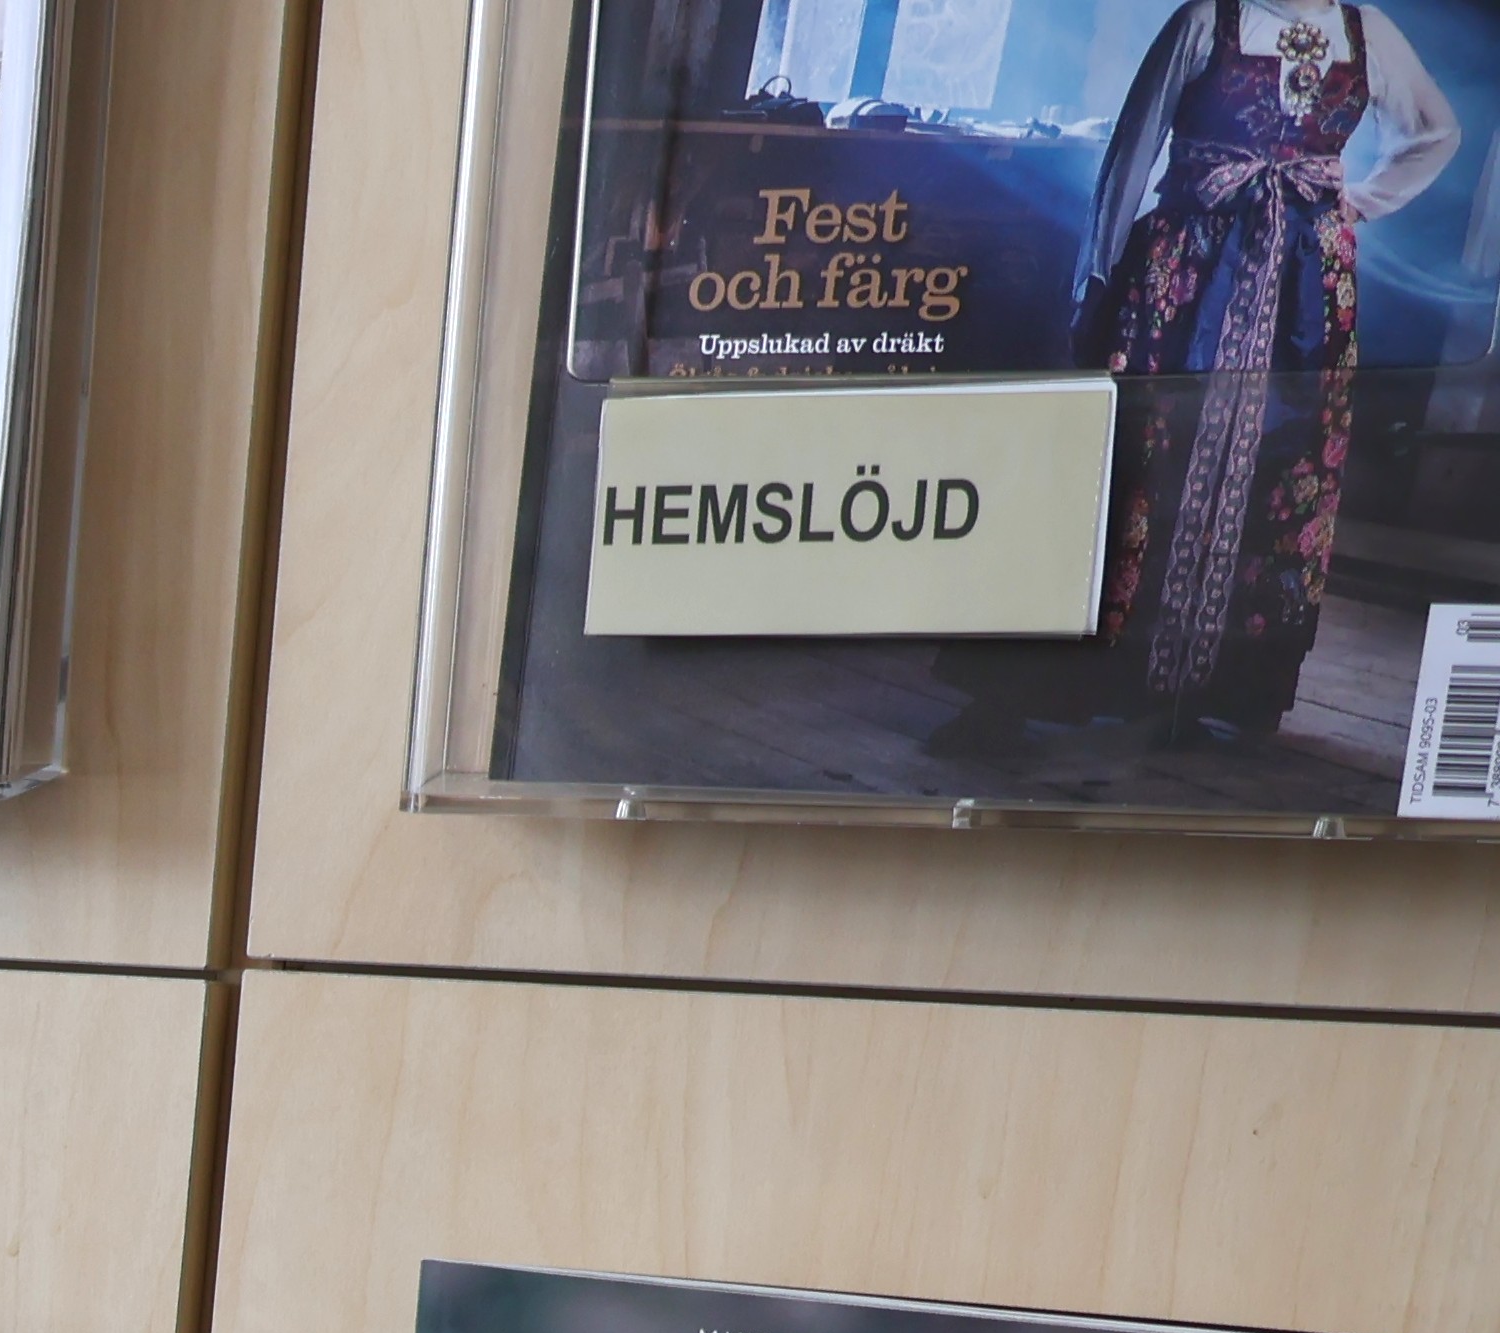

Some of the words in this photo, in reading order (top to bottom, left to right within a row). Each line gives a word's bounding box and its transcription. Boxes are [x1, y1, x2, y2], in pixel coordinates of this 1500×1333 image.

[754, 188, 908, 244] Fest
[689, 256, 802, 310] och
[821, 256, 967, 321] färg
[700, 334, 830, 358] Uppslukad
[837, 338, 867, 355] av
[873, 332, 943, 355] dräkt
[602, 465, 981, 547] HEMSLÖJD
